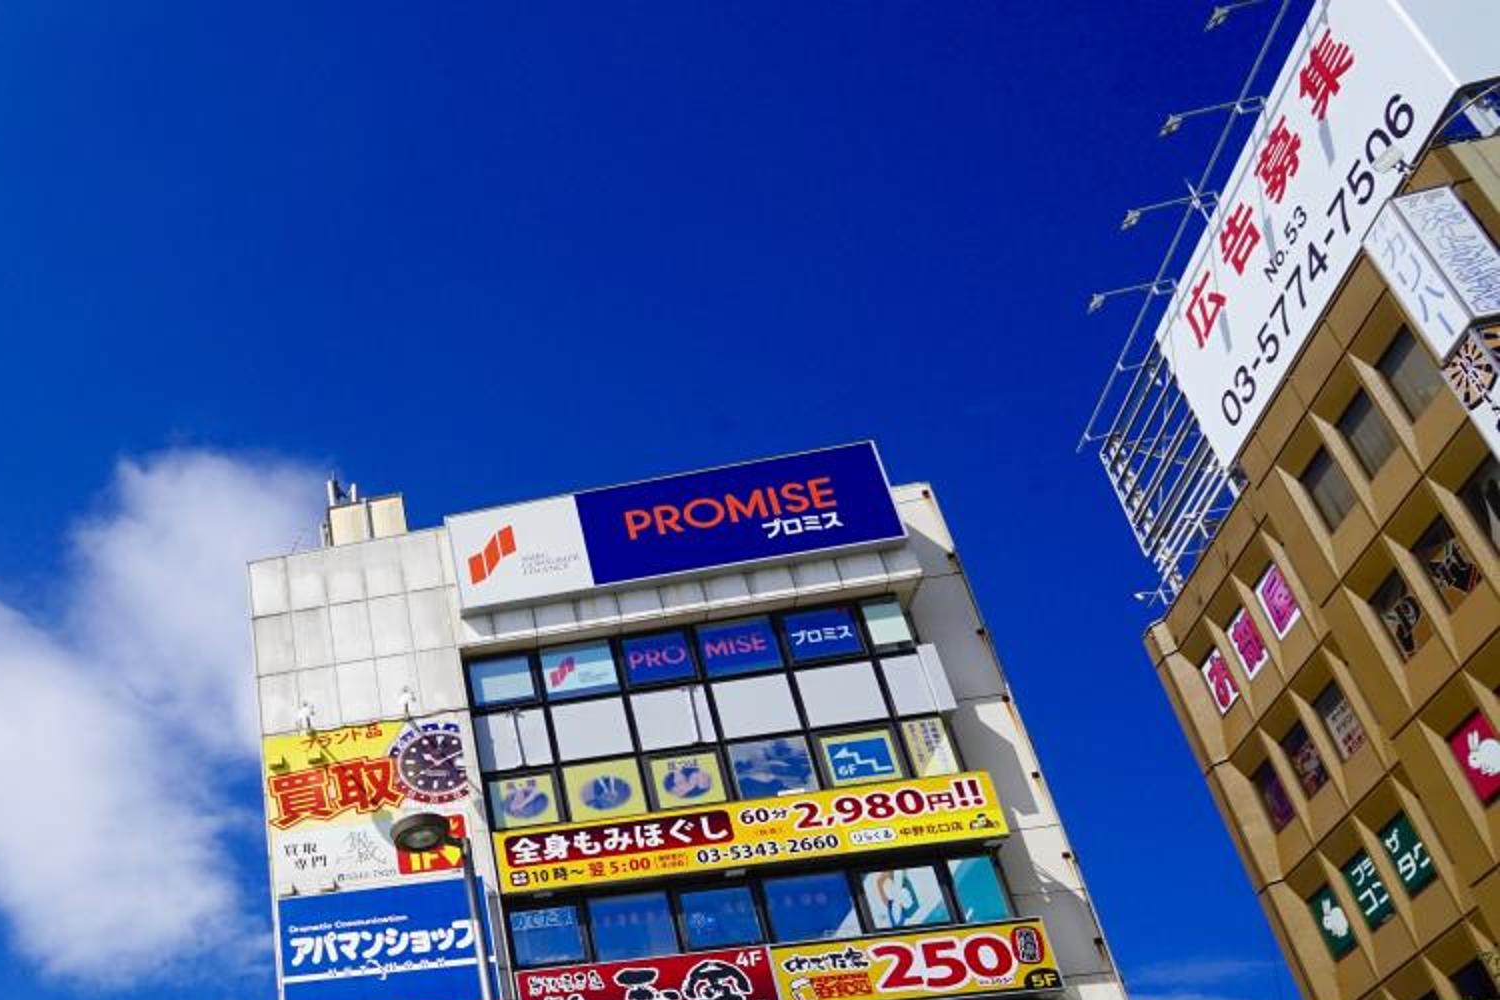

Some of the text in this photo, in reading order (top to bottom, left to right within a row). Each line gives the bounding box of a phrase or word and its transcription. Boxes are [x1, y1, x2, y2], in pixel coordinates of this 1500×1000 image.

[1185, 29, 1354, 349] 広告募集
[1263, 205, 1307, 283] No.53
[624, 477, 838, 541] PROMISE
[762, 511, 845, 541] プロミス
[791, 625, 854, 647] プロミス
[269, 757, 404, 831] 買取
[510, 815, 730, 866] 全身もみほぐし
[739, 807, 788, 825] 60分
[697, 834, 840, 865] 03-5343-2660
[736, 951, 763, 968] 4F
[1031, 975, 1057, 988] 5F
